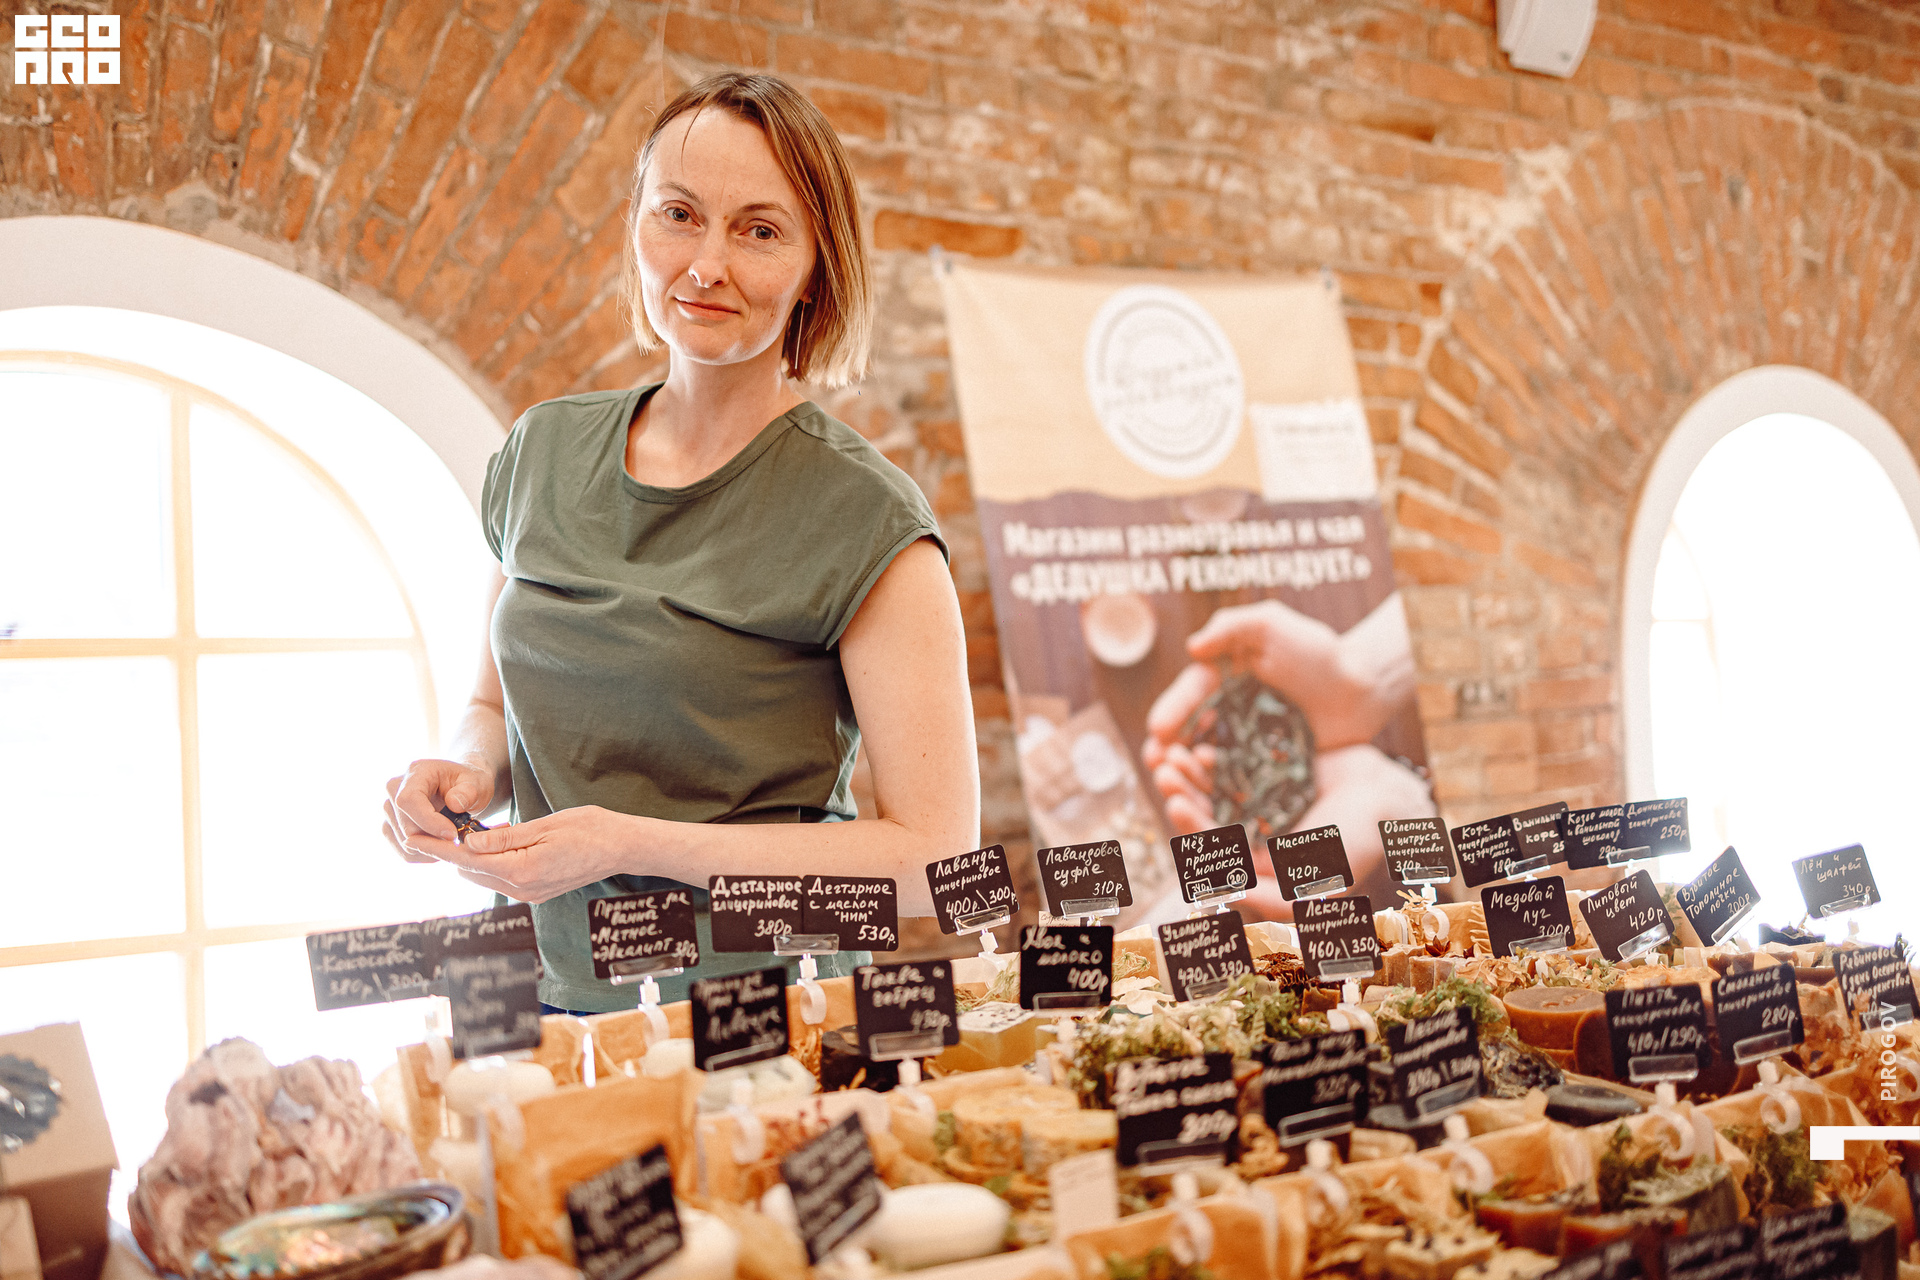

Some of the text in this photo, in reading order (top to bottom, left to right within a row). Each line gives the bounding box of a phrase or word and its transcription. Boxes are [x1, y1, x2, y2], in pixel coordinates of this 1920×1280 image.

[1003, 521, 1124, 556] Магазин
[1127, 519, 1293, 557] разнотравья
[1297, 520, 1316, 544] и
[1384, 820, 1437, 834] Облепиха
[1387, 832, 1441, 846] и цитрусы
[1457, 826, 1512, 852] глицериновое
[1462, 824, 1491, 840] Кофе
[1045, 841, 1122, 866] Лавандовое
[1181, 835, 1220, 854] Мёд и
[1185, 843, 1240, 870] прополис
[1387, 842, 1444, 858] глицериновое
[935, 850, 1000, 879] Лаванда
[1054, 863, 1104, 888] суфле
[1195, 857, 1244, 877] молоком
[1800, 858, 1823, 875] Лён
[1816, 857, 1862, 883] шалфей
[711, 876, 803, 899] Дегтярное
[808, 876, 893, 900] Дегтярное
[934, 866, 1001, 895] глицериновое
[1682, 862, 1720, 902] Взбитое
[712, 894, 799, 916] глицериновое
[809, 900, 879, 910] с маслом
[1491, 885, 1554, 912] Медовый
[1587, 876, 1637, 913] Липовый
[1605, 895, 1635, 918] цвет
[1710, 886, 1736, 914] почки
[1306, 900, 1355, 918] Лекарь
[1523, 908, 1551, 926] луг
[1298, 912, 1368, 935] глицериновое
[1021, 924, 1091, 951] Хвоя и
[1204, 933, 1239, 959] скраб
[1036, 949, 1103, 966] молоко
[1840, 947, 1898, 971] Рябиновое
[1717, 967, 1780, 996] Смоляное
[1622, 987, 1678, 1008] Пихта
[1718, 981, 1792, 1014] глицериновое
